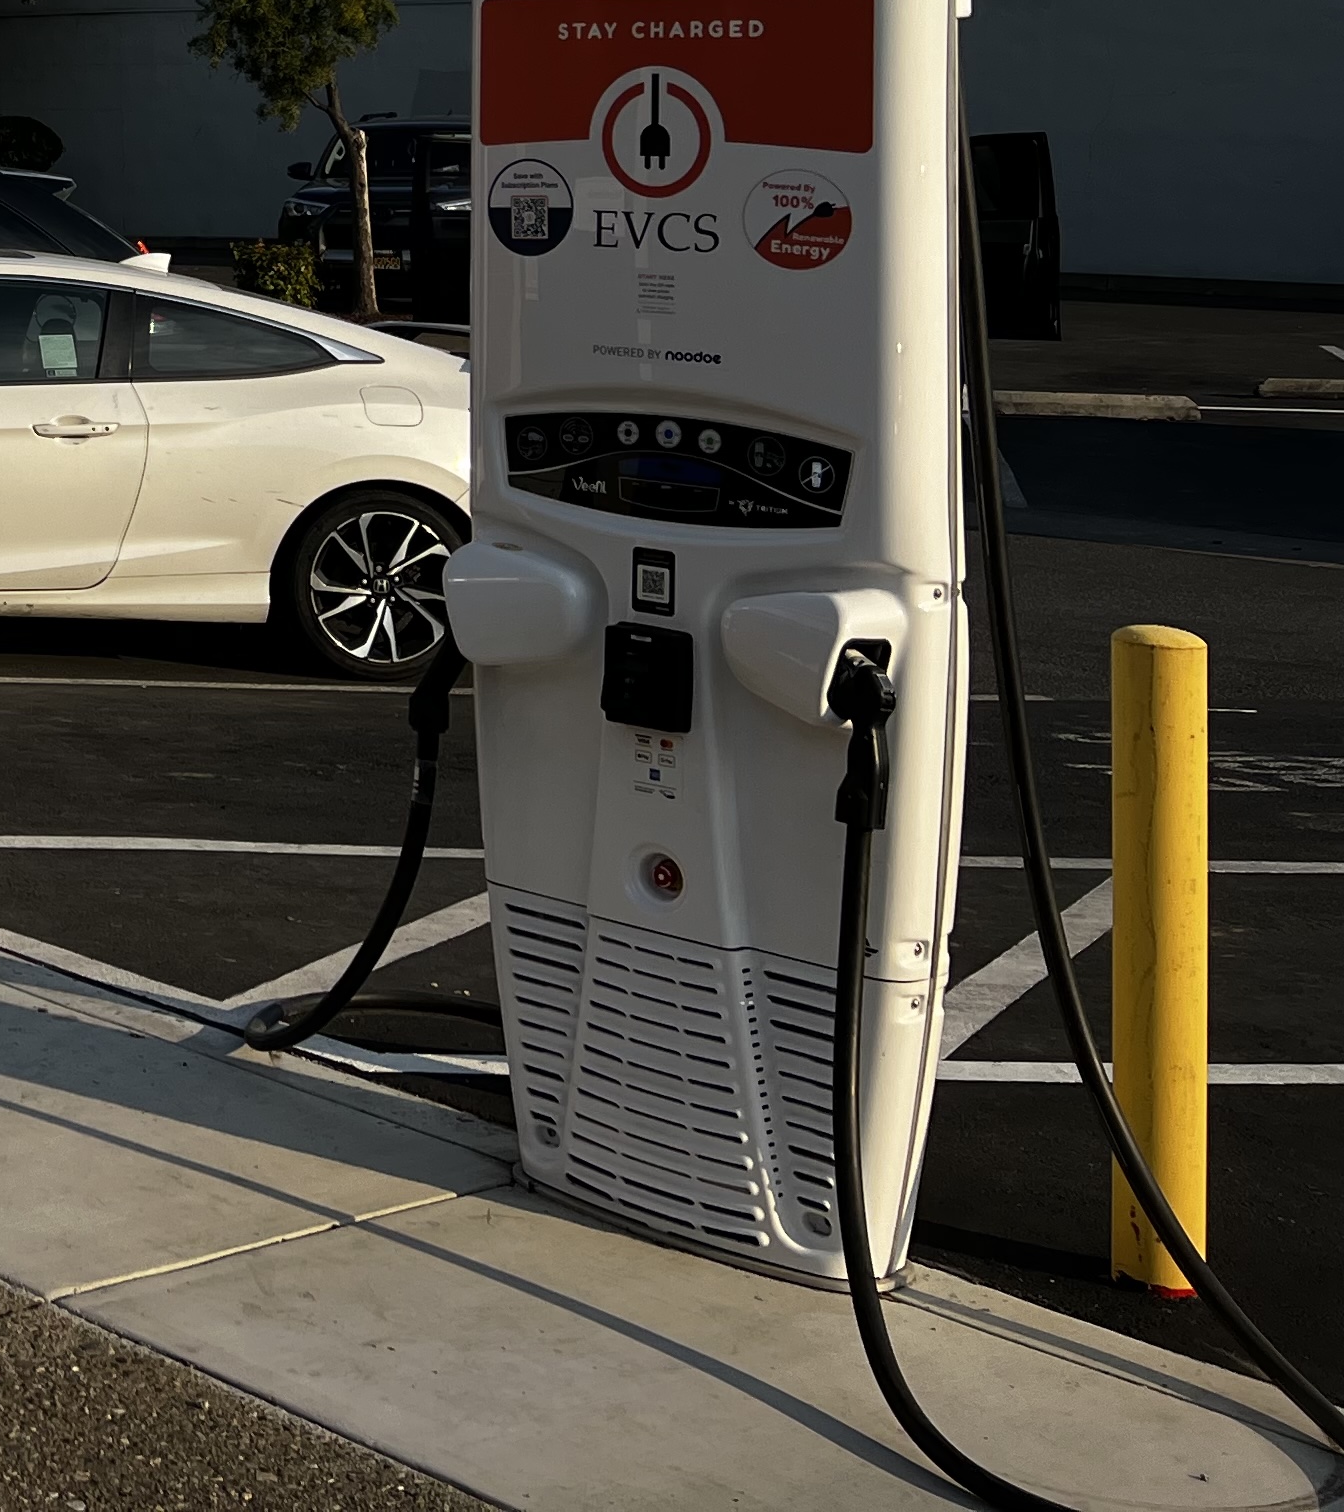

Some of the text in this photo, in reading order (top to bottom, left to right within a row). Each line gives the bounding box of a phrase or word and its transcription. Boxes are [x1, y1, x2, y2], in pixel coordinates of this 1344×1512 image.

[558, 19, 765, 40] STAY CHARGED
[772, 194, 815, 210] 100%
[593, 209, 720, 253] EVCS
[770, 239, 831, 261] Energy
[592, 344, 722, 365] POWERED BY noodoe
